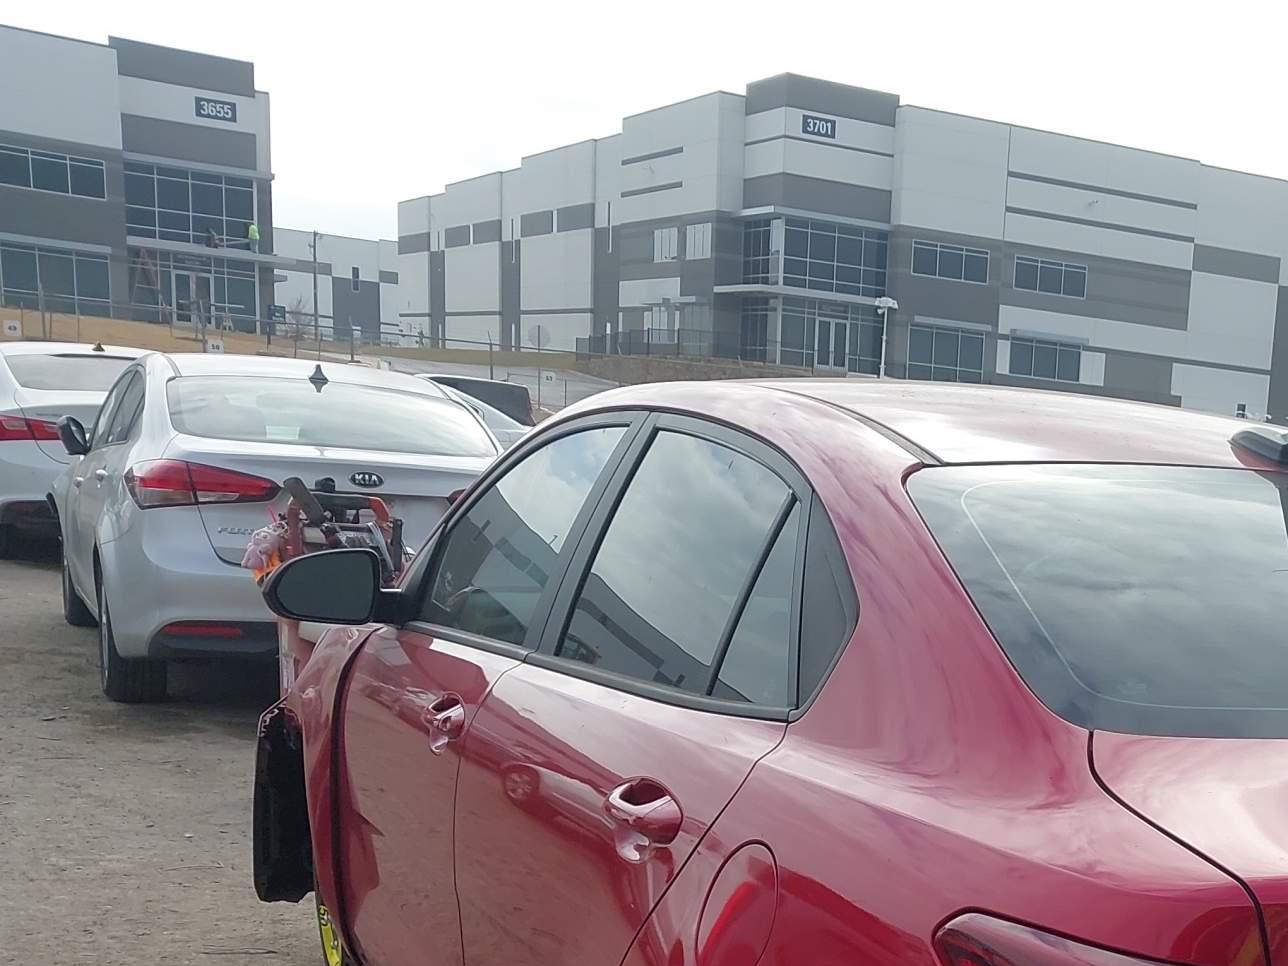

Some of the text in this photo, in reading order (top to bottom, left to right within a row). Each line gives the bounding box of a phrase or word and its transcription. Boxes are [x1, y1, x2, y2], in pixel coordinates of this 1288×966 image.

[200, 101, 232, 118] 3655
[807, 118, 831, 135] 3701
[354, 473, 379, 484] KIA
